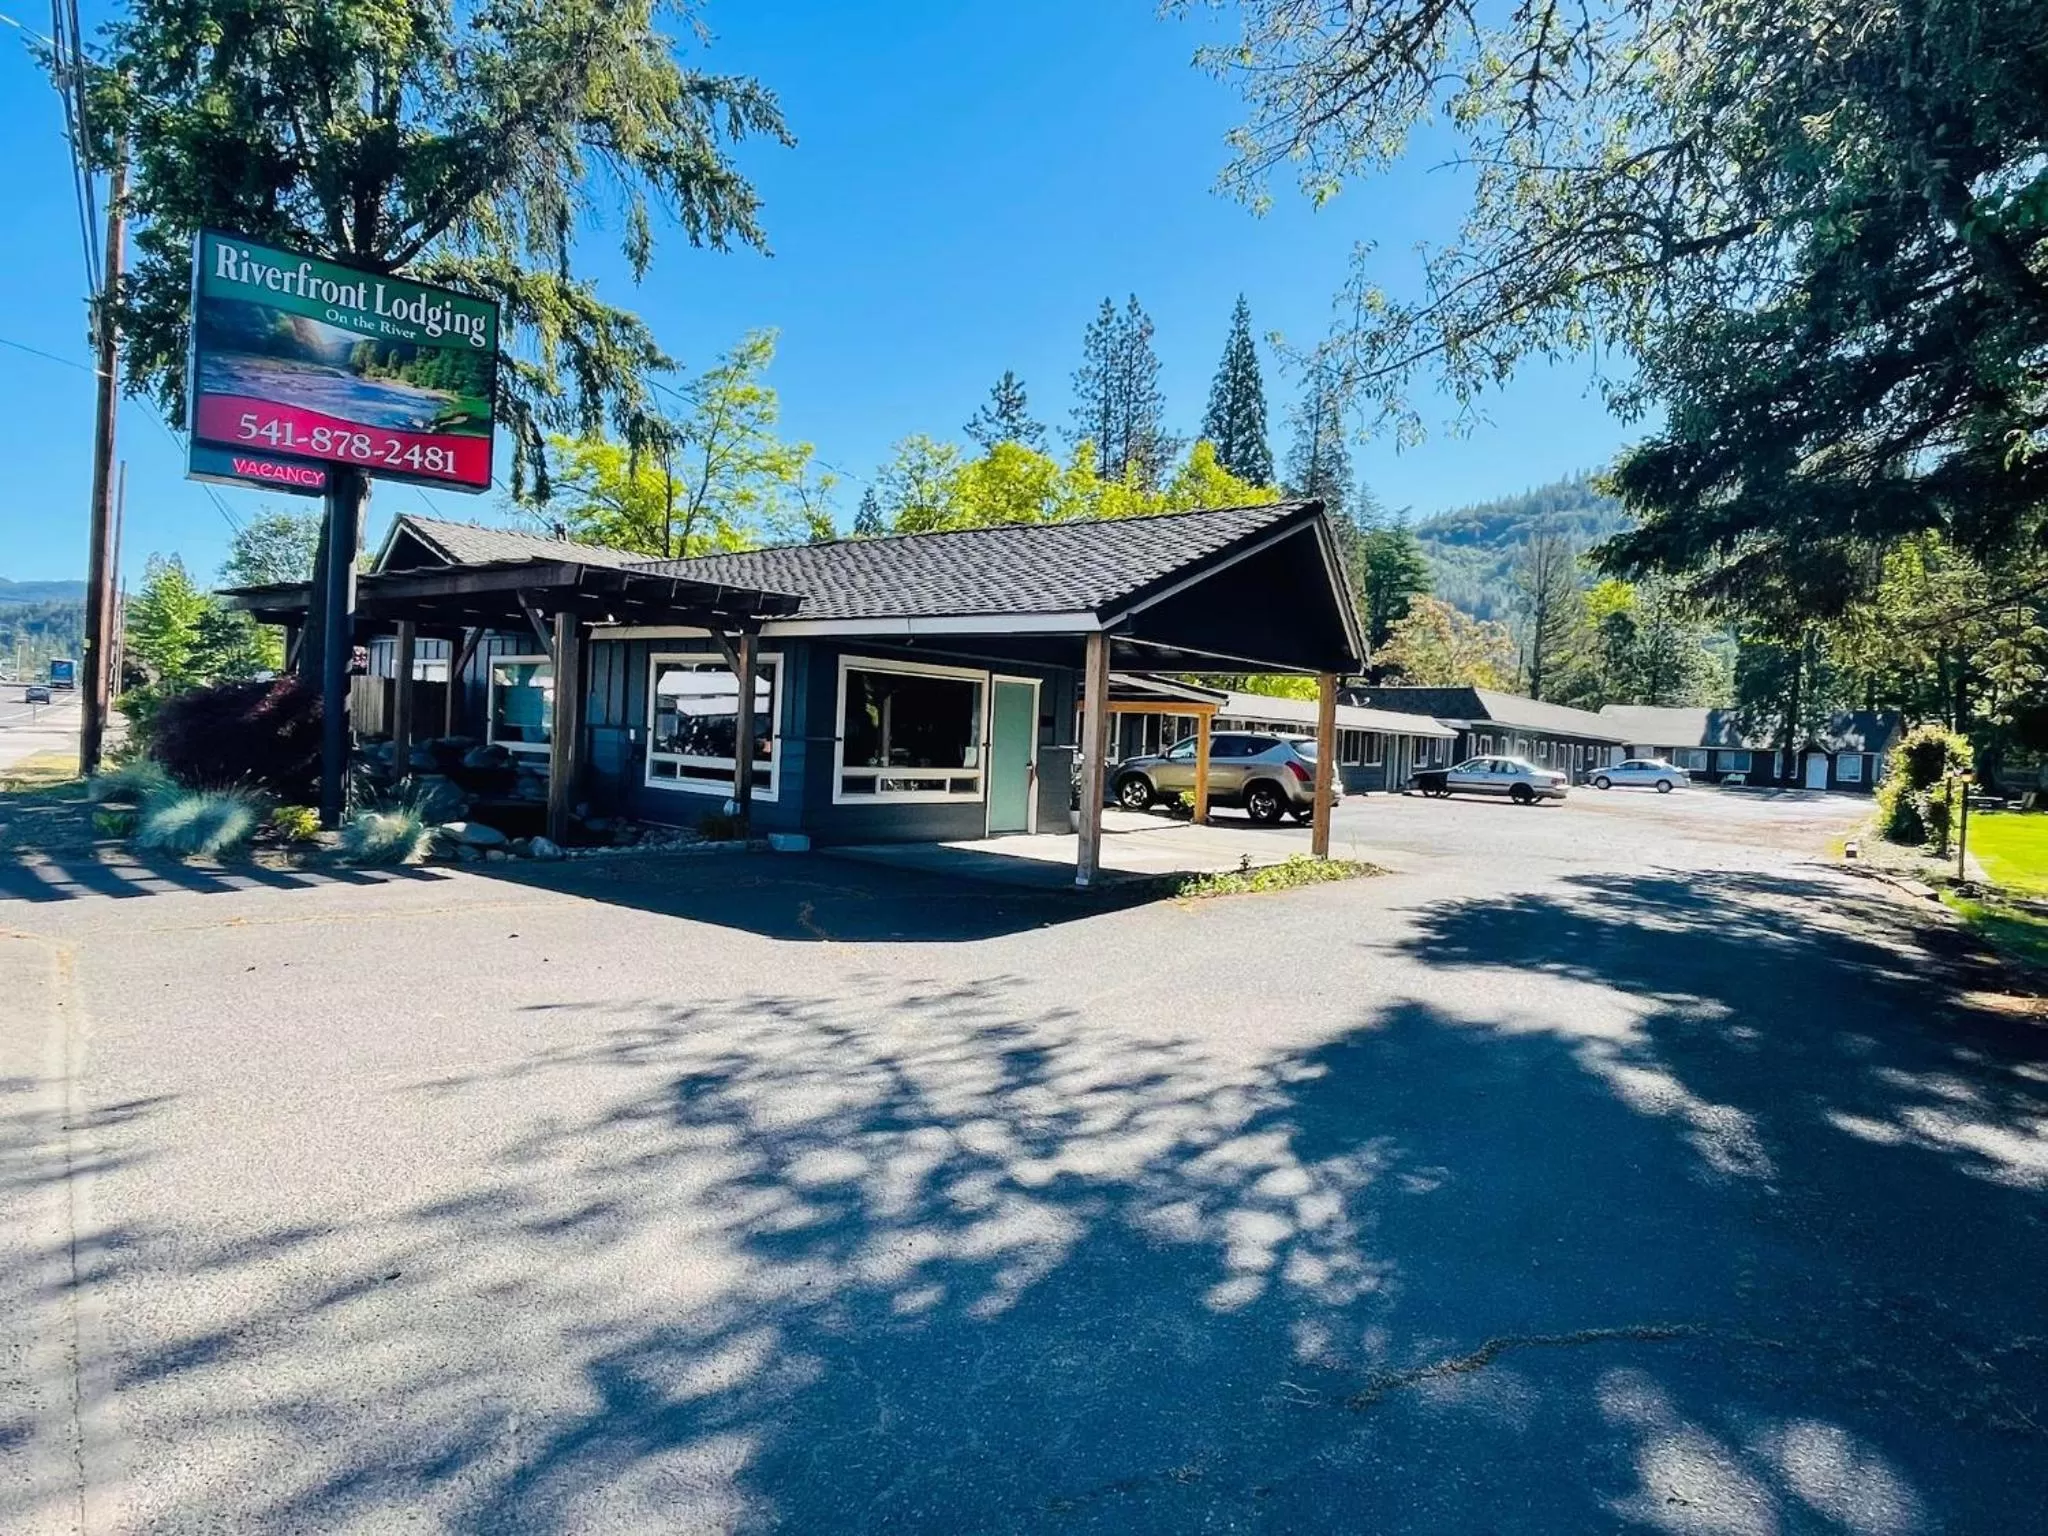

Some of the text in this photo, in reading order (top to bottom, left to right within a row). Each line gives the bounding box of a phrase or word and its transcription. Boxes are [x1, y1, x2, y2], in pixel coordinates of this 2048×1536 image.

[215, 242, 486, 348] Riverfront Lodging
[325, 309, 417, 339] On the River
[237, 413, 457, 474] 541-878-2481
[232, 457, 326, 487] VACANCY
